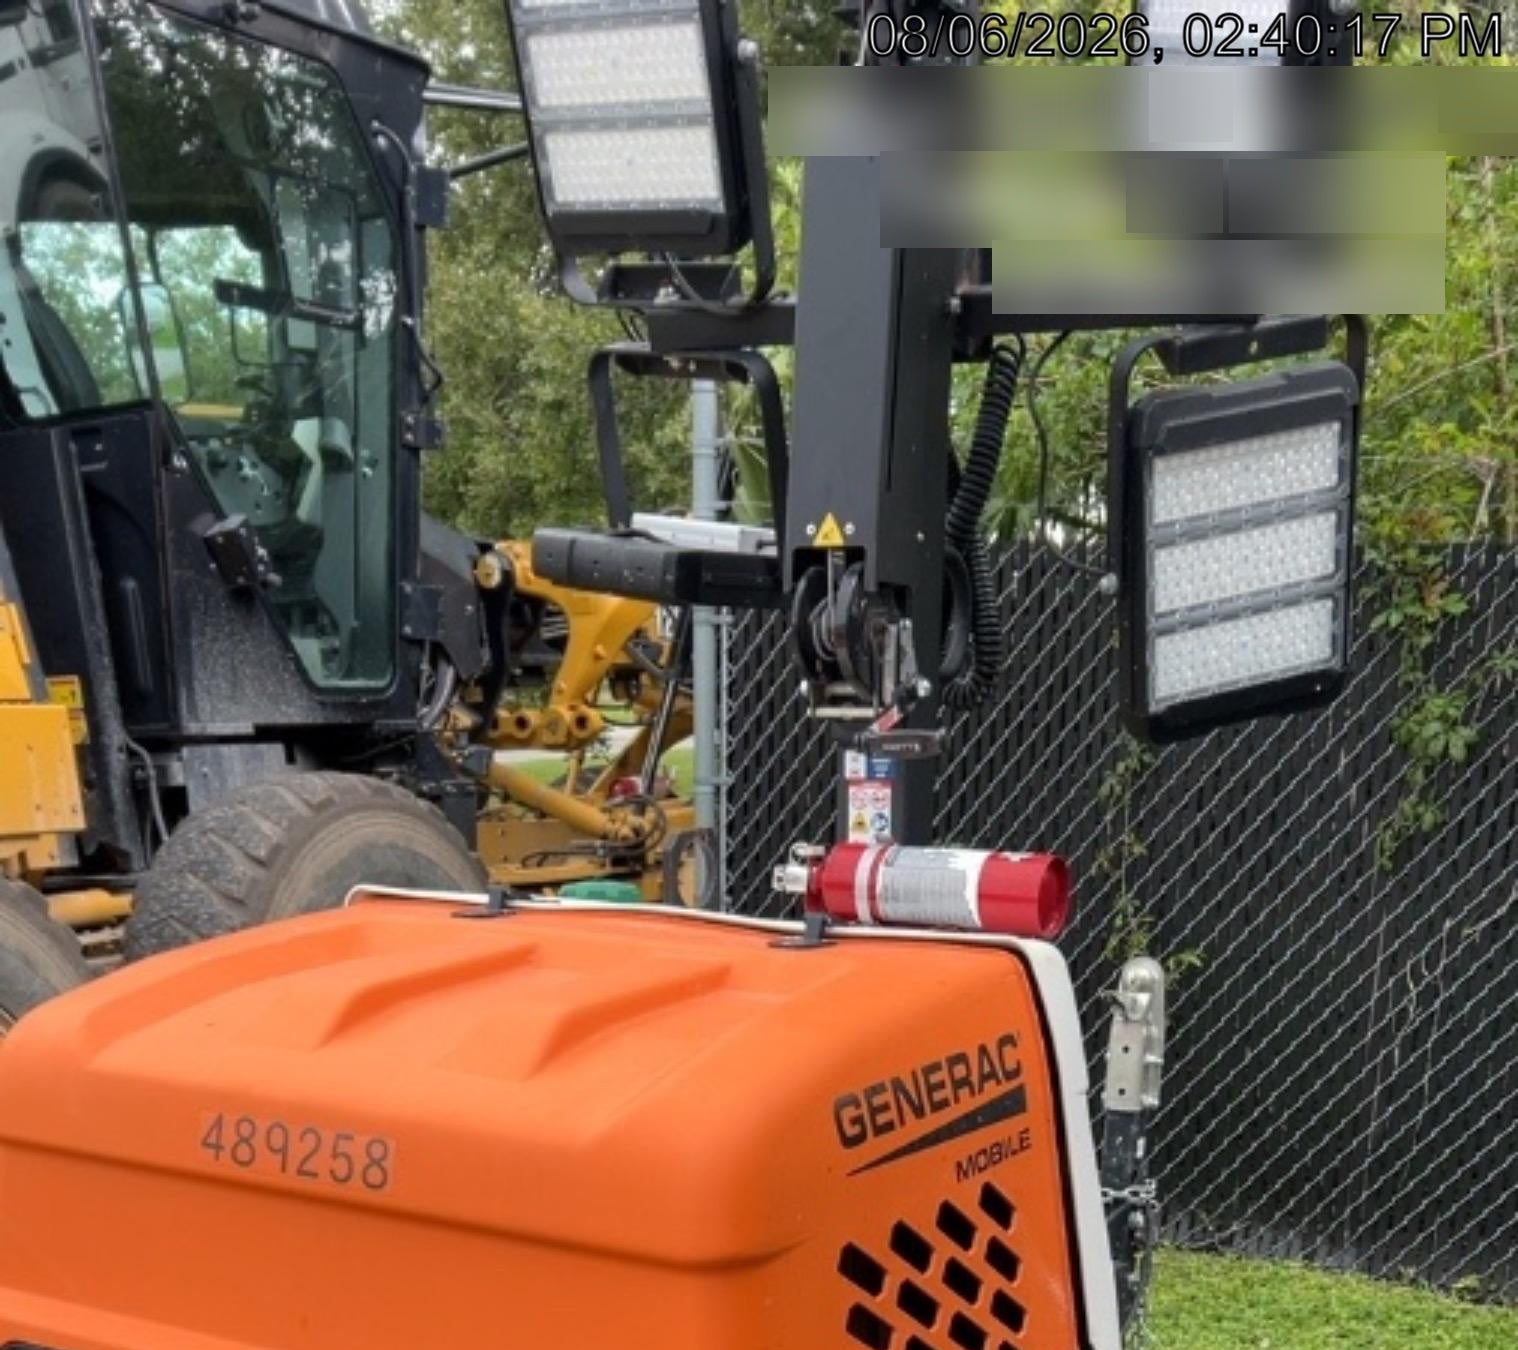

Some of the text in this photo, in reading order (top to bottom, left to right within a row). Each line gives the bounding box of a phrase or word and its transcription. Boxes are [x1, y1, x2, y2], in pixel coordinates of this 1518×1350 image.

[834, 1033, 1022, 1150] GENERAC
[201, 1112, 389, 1190] 489258
[955, 1127, 1032, 1183] MOBILE
